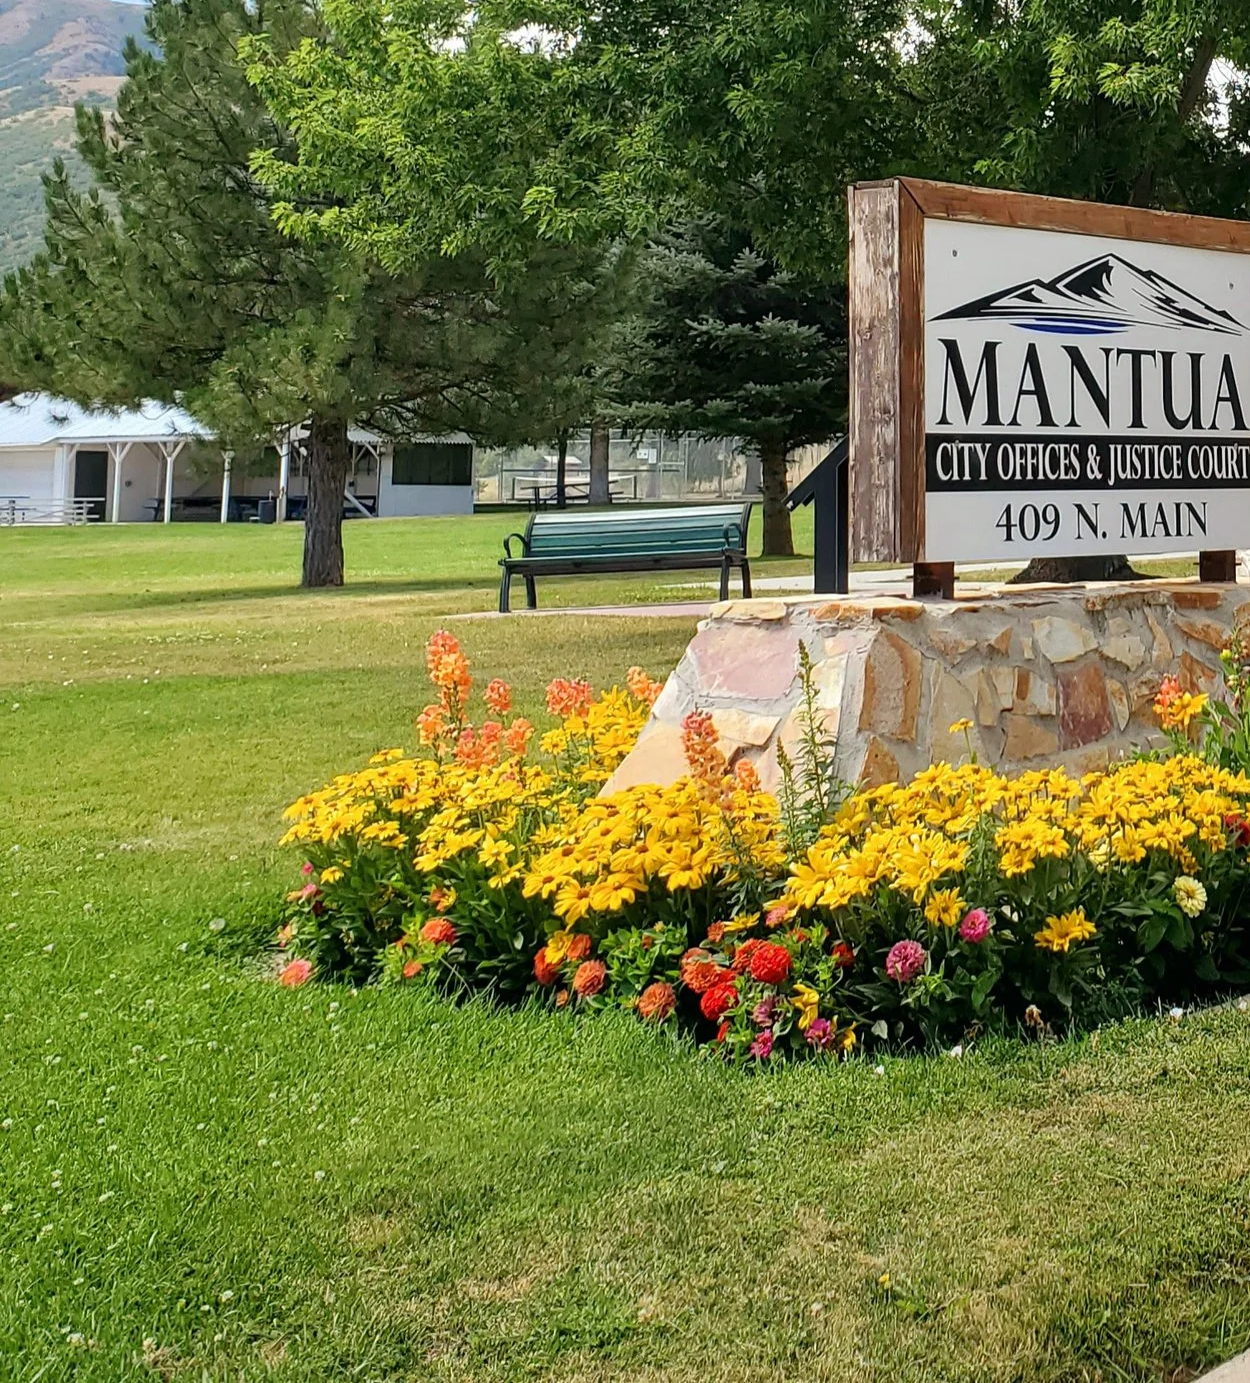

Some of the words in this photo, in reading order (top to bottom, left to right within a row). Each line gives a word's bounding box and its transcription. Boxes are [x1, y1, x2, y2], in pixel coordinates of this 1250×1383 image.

[935, 338, 1250, 431] MANTUA
[936, 441, 990, 481] CITY
[997, 443, 1080, 480] OFFICES
[1086, 443, 1103, 480] &
[1108, 443, 1183, 486] JUSTICE
[1187, 443, 1250, 479] COURT
[995, 503, 1061, 542] 409
[1073, 503, 1108, 540] N.
[1119, 501, 1208, 539] MAIN
